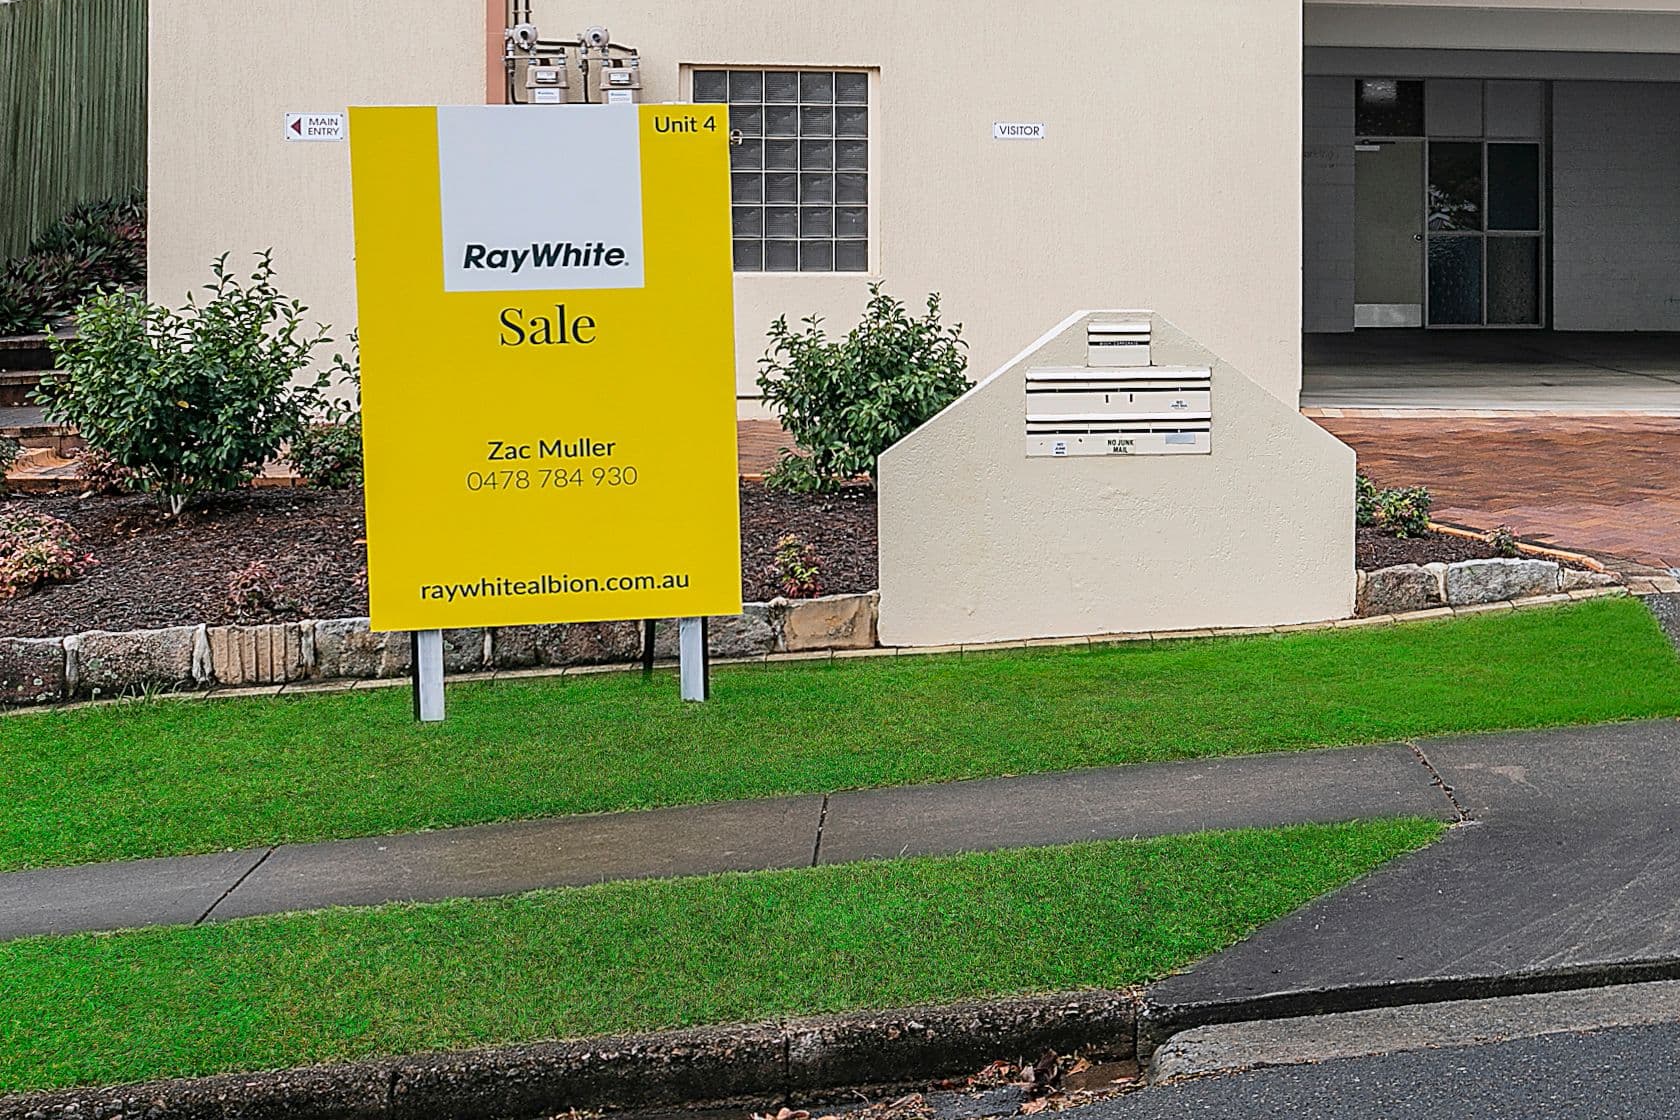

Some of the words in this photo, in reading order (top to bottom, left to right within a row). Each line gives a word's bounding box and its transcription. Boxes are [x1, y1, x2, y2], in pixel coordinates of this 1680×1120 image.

[308, 127, 339, 135] ENTRY
[309, 118, 338, 126] MAIN
[655, 116, 697, 132] Unit
[703, 116, 716, 132] 4
[999, 125, 1040, 136] VISITOR
[499, 304, 597, 346] Sale
[487, 440, 531, 460] Zac
[539, 438, 616, 459] Muller
[467, 470, 530, 491] 0478
[538, 468, 584, 488] 784
[592, 466, 637, 486] 930
[420, 573, 689, 602] raywhitealbion.com.au
